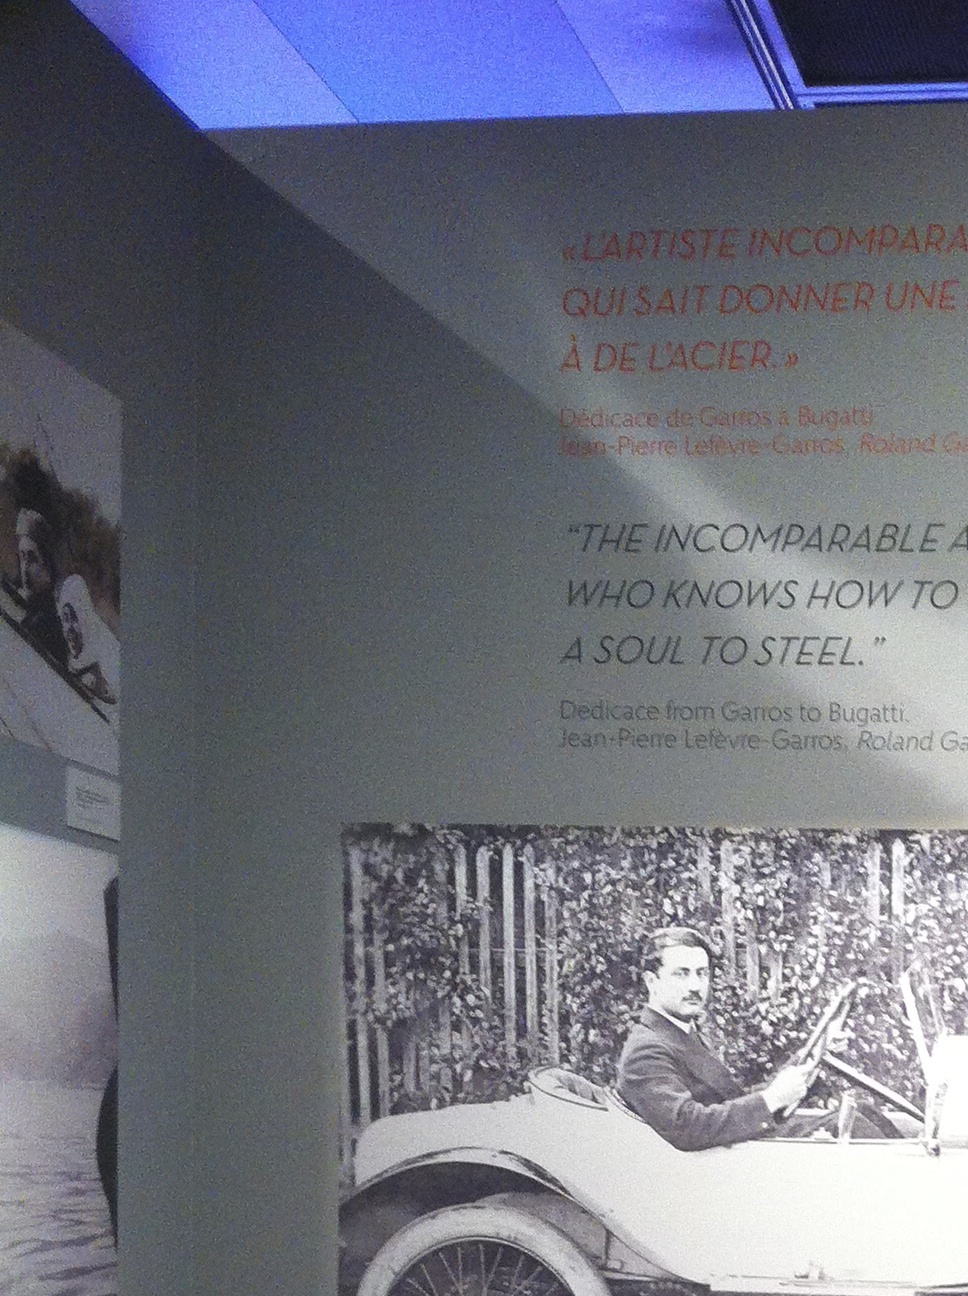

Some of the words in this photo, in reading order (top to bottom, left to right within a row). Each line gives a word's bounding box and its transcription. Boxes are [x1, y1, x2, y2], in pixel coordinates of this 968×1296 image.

[562, 286, 626, 319] QUI
[634, 284, 708, 317] SAIT
[718, 280, 876, 315] DONNER
[885, 274, 958, 312] UNE
[560, 331, 582, 372] À
[593, 342, 639, 372] DE
[666, 408, 693, 428] de
[700, 406, 772, 427] Garros
[859, 432, 935, 455] Roland
[654, 523, 945, 553] INCOMPARABLE
[567, 579, 655, 609] WHO
[662, 579, 798, 609] KNOWS
[806, 579, 904, 609] HOW
[911, 579, 959, 610] TO
[560, 636, 583, 664] A
[593, 635, 685, 665] SOUL
[701, 635, 748, 665] TO
[559, 701, 660, 722] Dedicace
[666, 701, 714, 721] from
[721, 700, 793, 722] Garros
[799, 703, 822, 722] to
[829, 702, 910, 727] Bugatti.
[559, 727, 677, 749] Jean-Pierre
[857, 730, 934, 751] Roland
